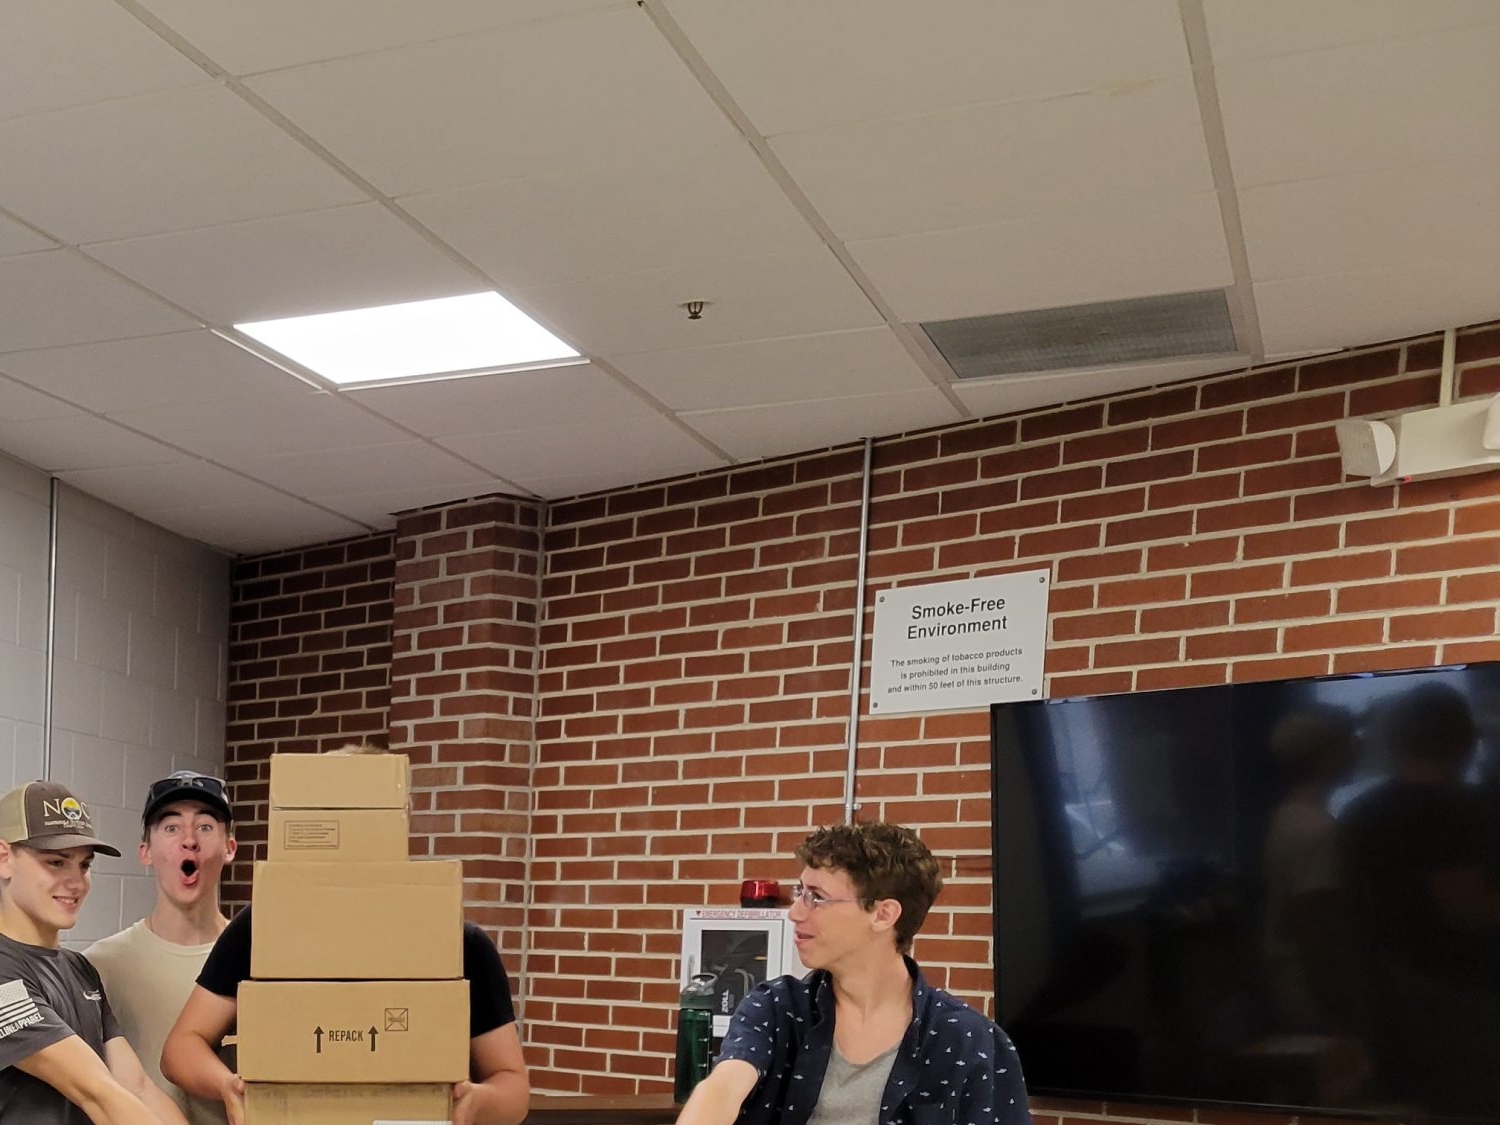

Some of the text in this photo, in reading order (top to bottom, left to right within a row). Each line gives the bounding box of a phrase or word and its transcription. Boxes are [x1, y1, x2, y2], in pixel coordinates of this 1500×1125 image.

[911, 597, 1006, 620] Smoke-Free
[907, 615, 1008, 640] Environment
[891, 647, 1023, 668] The smoking of tobacco products
[900, 662, 1011, 680] is prohibited in this building
[887, 685, 902, 694] and
[903, 682, 927, 692] within
[928, 681, 939, 691] 50
[940, 680, 955, 690] feet
[956, 678, 965, 688] of
[966, 677, 982, 687] this
[328, 1029, 364, 1042] REPACK
